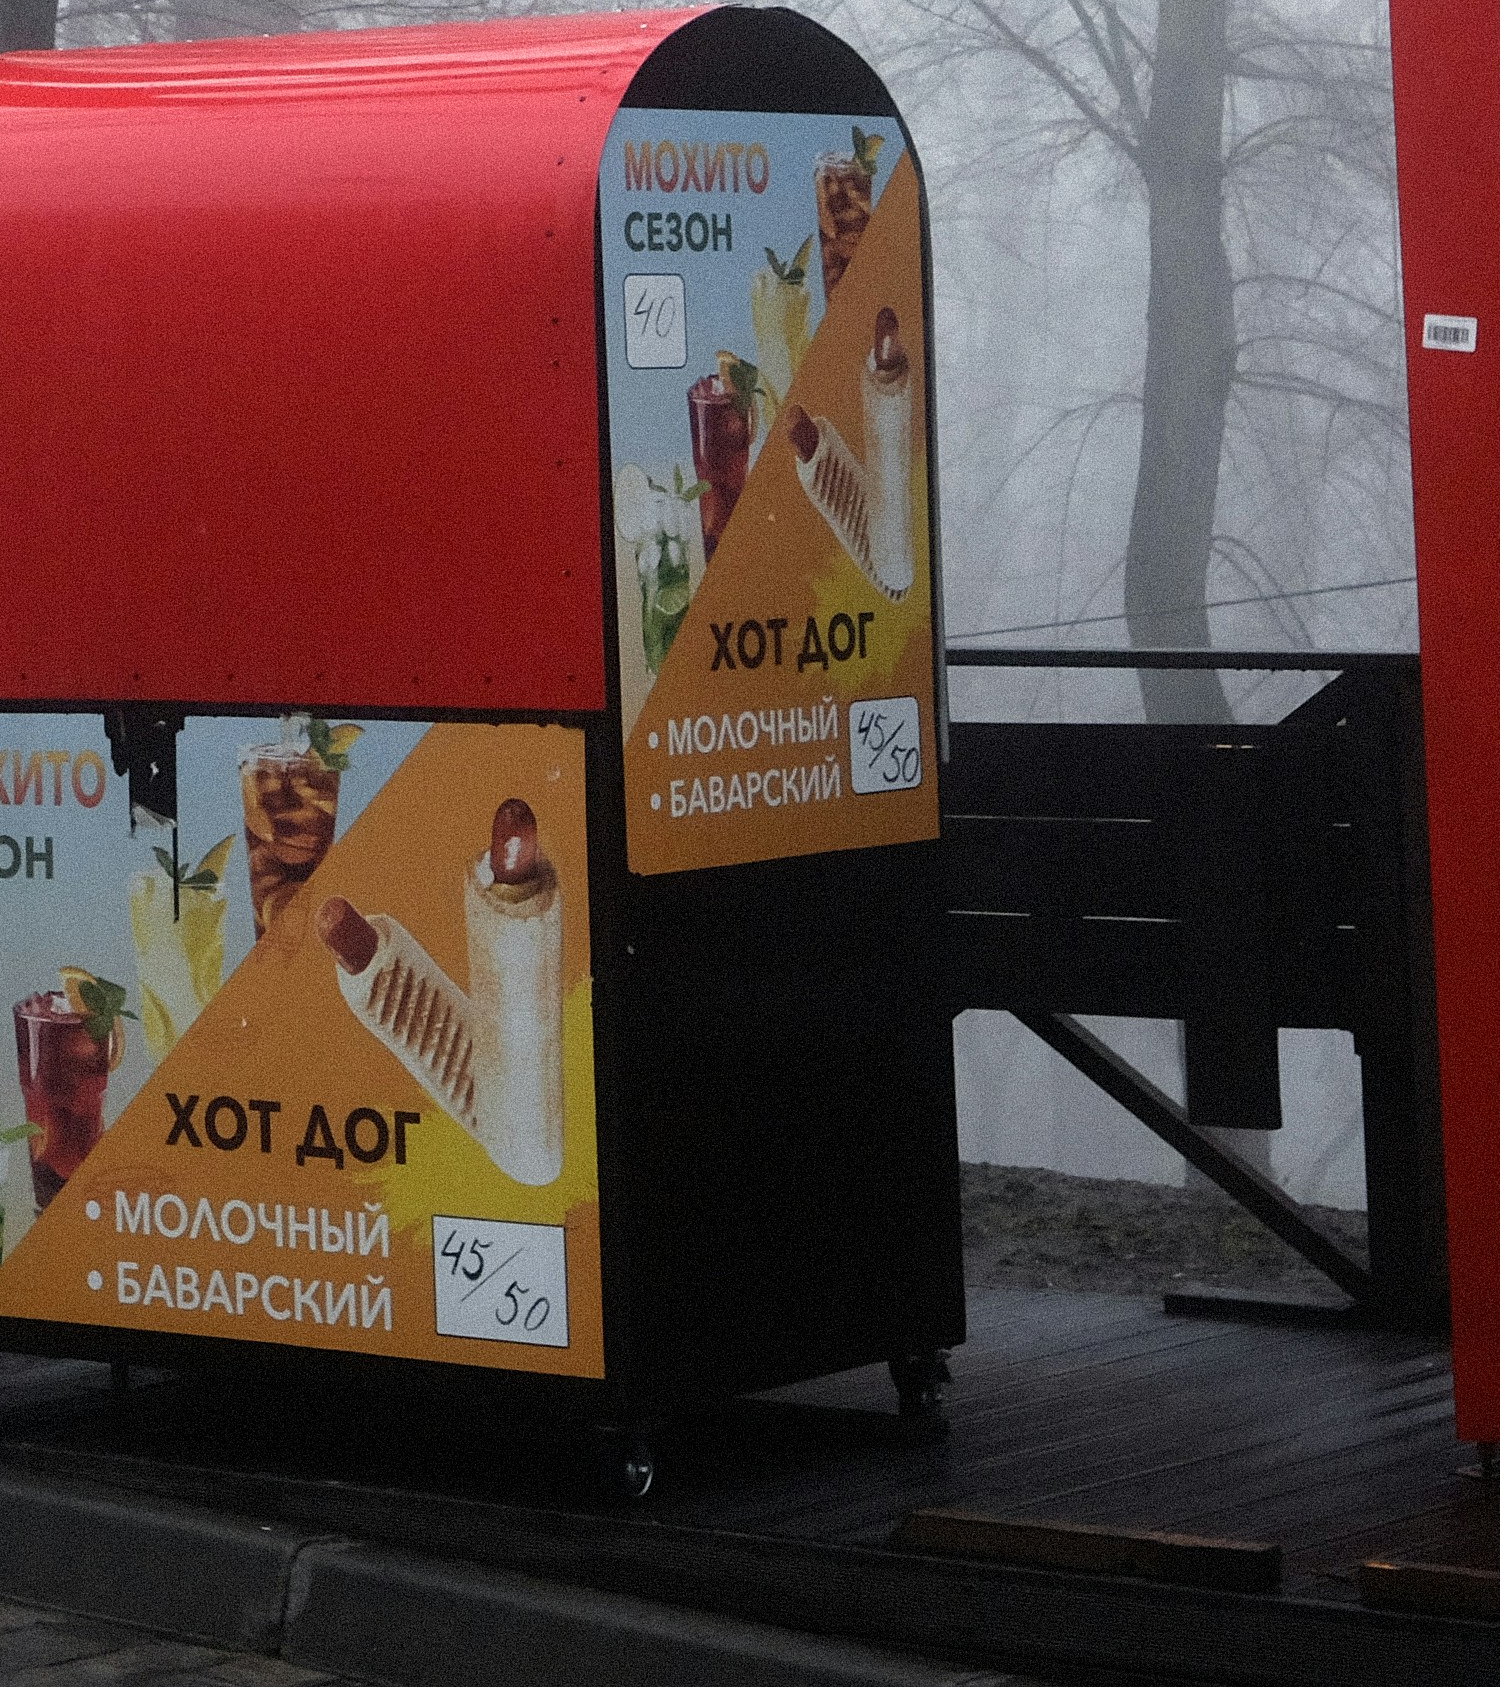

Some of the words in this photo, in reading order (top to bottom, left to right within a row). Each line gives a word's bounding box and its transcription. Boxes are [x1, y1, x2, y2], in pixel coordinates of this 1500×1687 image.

[624, 140, 769, 194] МОХИТО
[624, 212, 732, 251] СЕЗОН
[633, 288, 676, 338] 40
[710, 618, 788, 671] ХОТ
[797, 612, 874, 673] ДОГ
[667, 695, 839, 755] МОЛОЧНЫЙ
[670, 754, 842, 818] БАВАРСКИЙ
[165, 1093, 281, 1153] ХОТ
[296, 1106, 420, 1169] ДОГ
[115, 1190, 390, 1258] МОЛОЧНЫЙ
[116, 1261, 393, 1331] БАВАРСКИЙ
